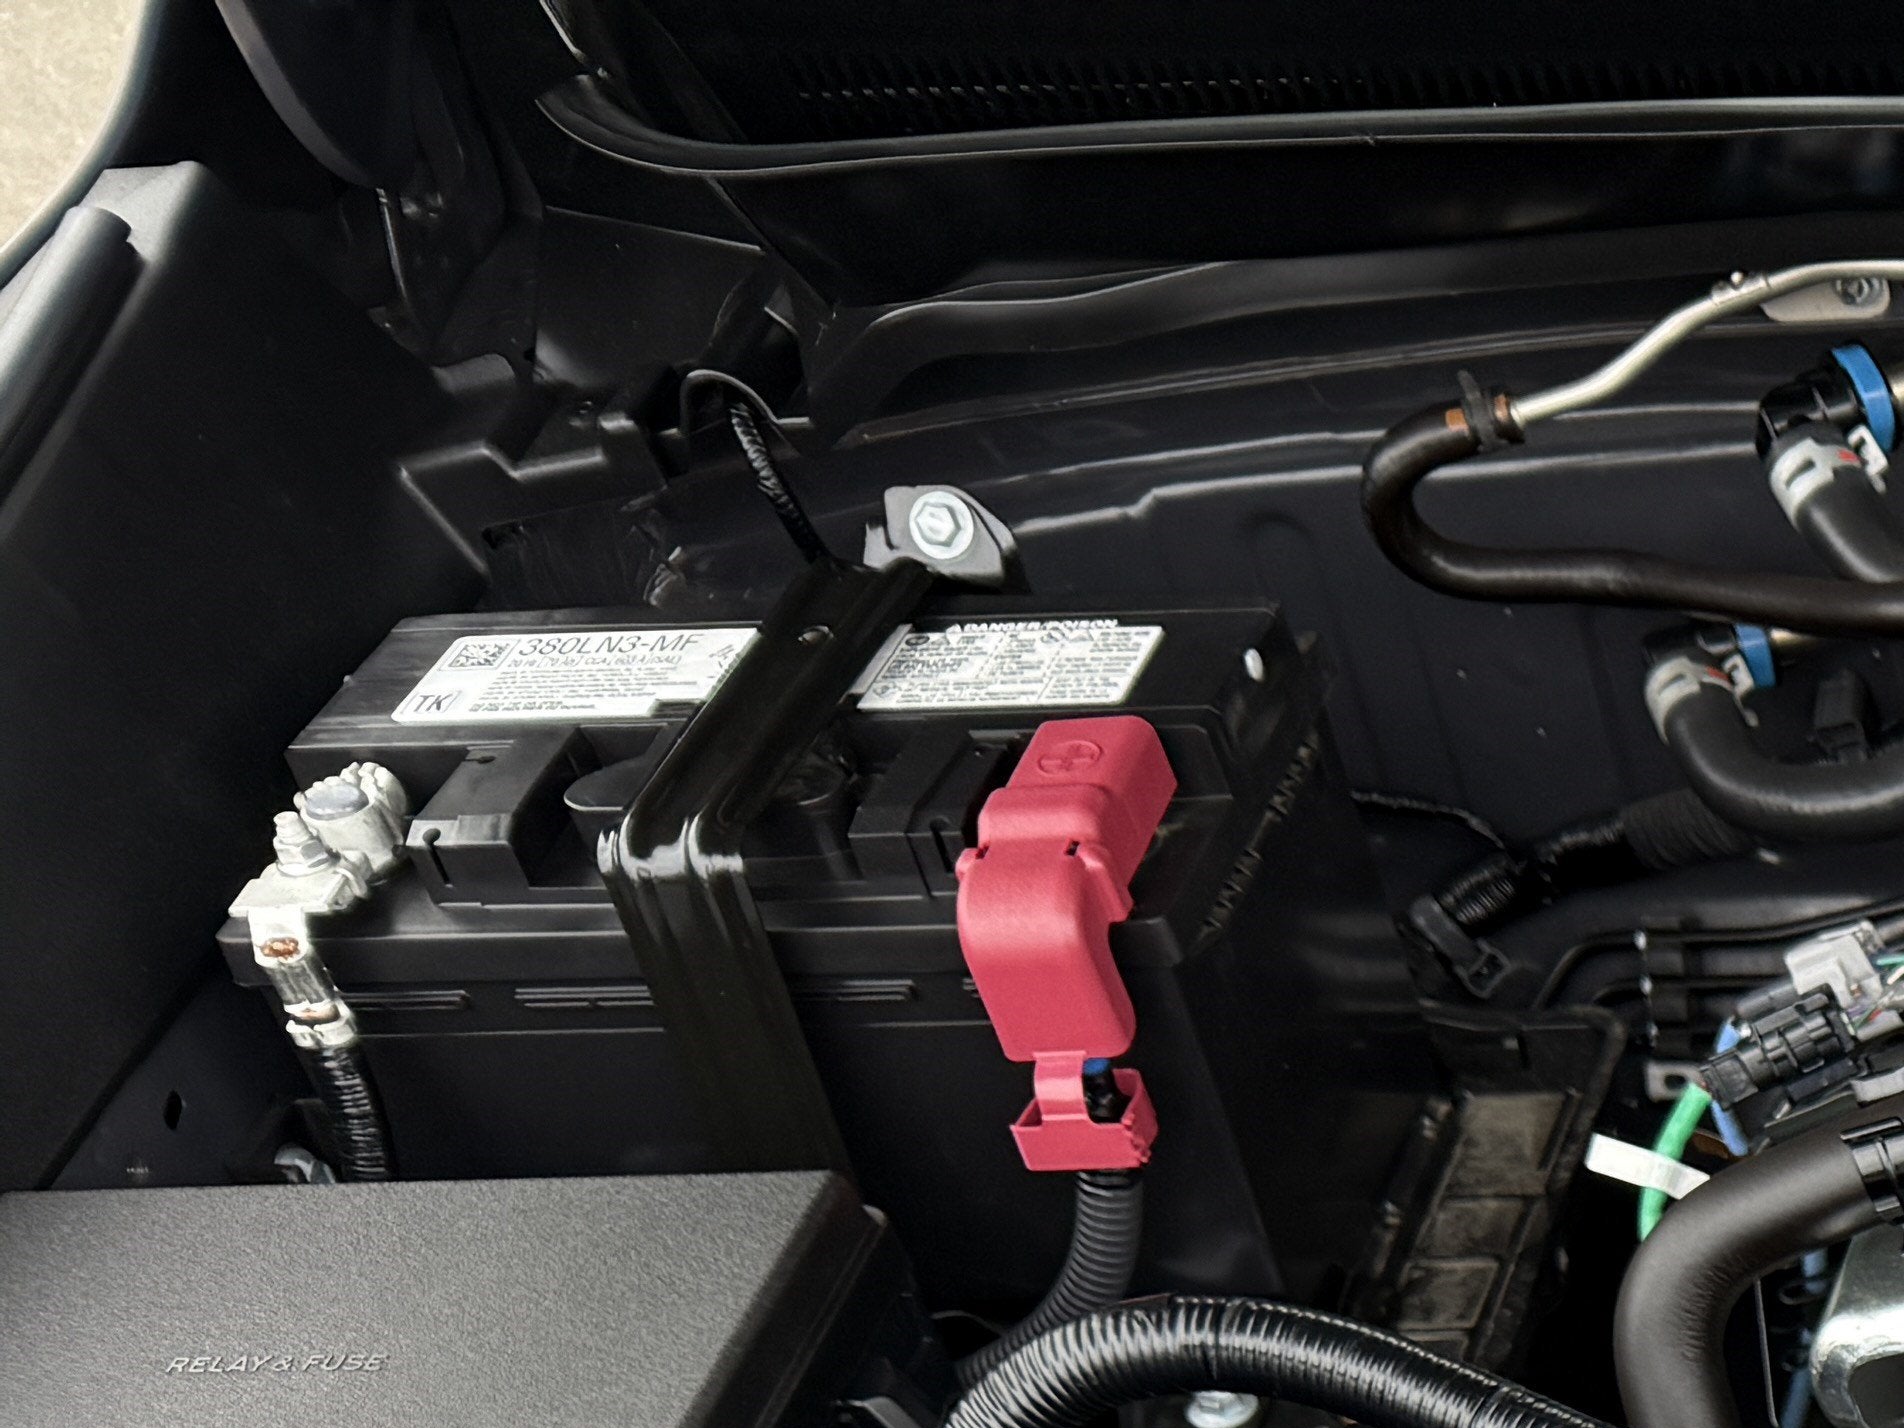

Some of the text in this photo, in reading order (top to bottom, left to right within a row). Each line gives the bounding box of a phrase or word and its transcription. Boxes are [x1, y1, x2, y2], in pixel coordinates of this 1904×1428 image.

[519, 634, 704, 656] 380LN3-MF
[413, 694, 448, 712] TK
[166, 1354, 390, 1375] RELAY & FUSE
